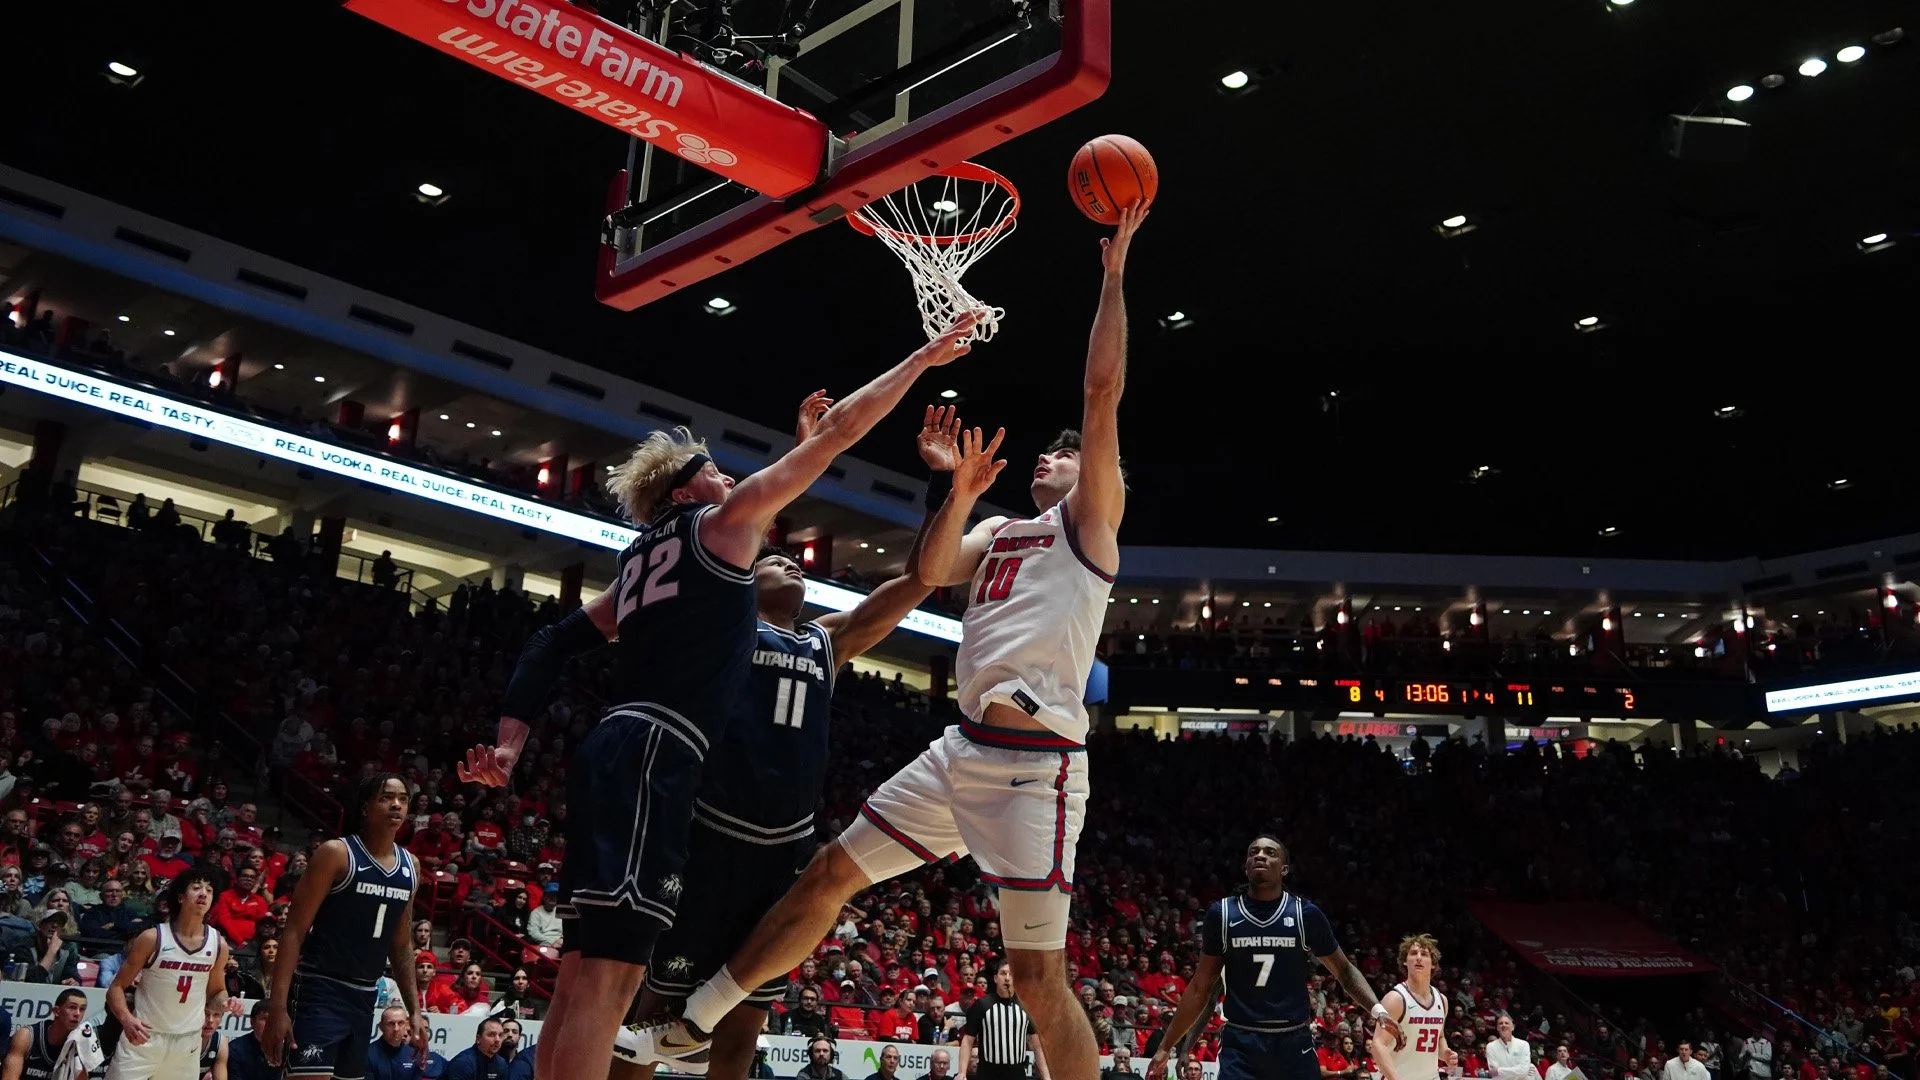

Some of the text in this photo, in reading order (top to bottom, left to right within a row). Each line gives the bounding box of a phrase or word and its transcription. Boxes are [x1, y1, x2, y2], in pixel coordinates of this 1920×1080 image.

[1078, 169, 1105, 215] ELITE
[45, 373, 104, 399] JUICE.
[108, 391, 153, 413] REAL
[275, 438, 315, 458] REAL
[321, 451, 377, 475] VODKA.
[381, 468, 418, 486] REAL
[422, 479, 468, 500] JUICE.
[471, 493, 506, 511] REAL
[600, 529, 631, 545] REAL
[617, 537, 681, 626] 22
[976, 556, 1023, 604] 10
[752, 650, 824, 681] UTAH STE
[773, 677, 807, 729] 11
[1350, 686, 1361, 702] 8
[1375, 690, 1385, 702] 4
[1406, 684, 1449, 702] 13:06
[1462, 690, 1467, 704] 1
[1485, 692, 1494, 705] 4
[1518, 692, 1533, 705] 11
[1625, 694, 1634, 709] 2
[356, 882, 411, 901] UTAH STATE
[373, 903, 387, 938] 1
[1231, 936, 1296, 948] UTAH STATE
[1253, 954, 1275, 987] 7
[176, 976, 192, 1003] 4
[1415, 1028, 1439, 1053] 23
